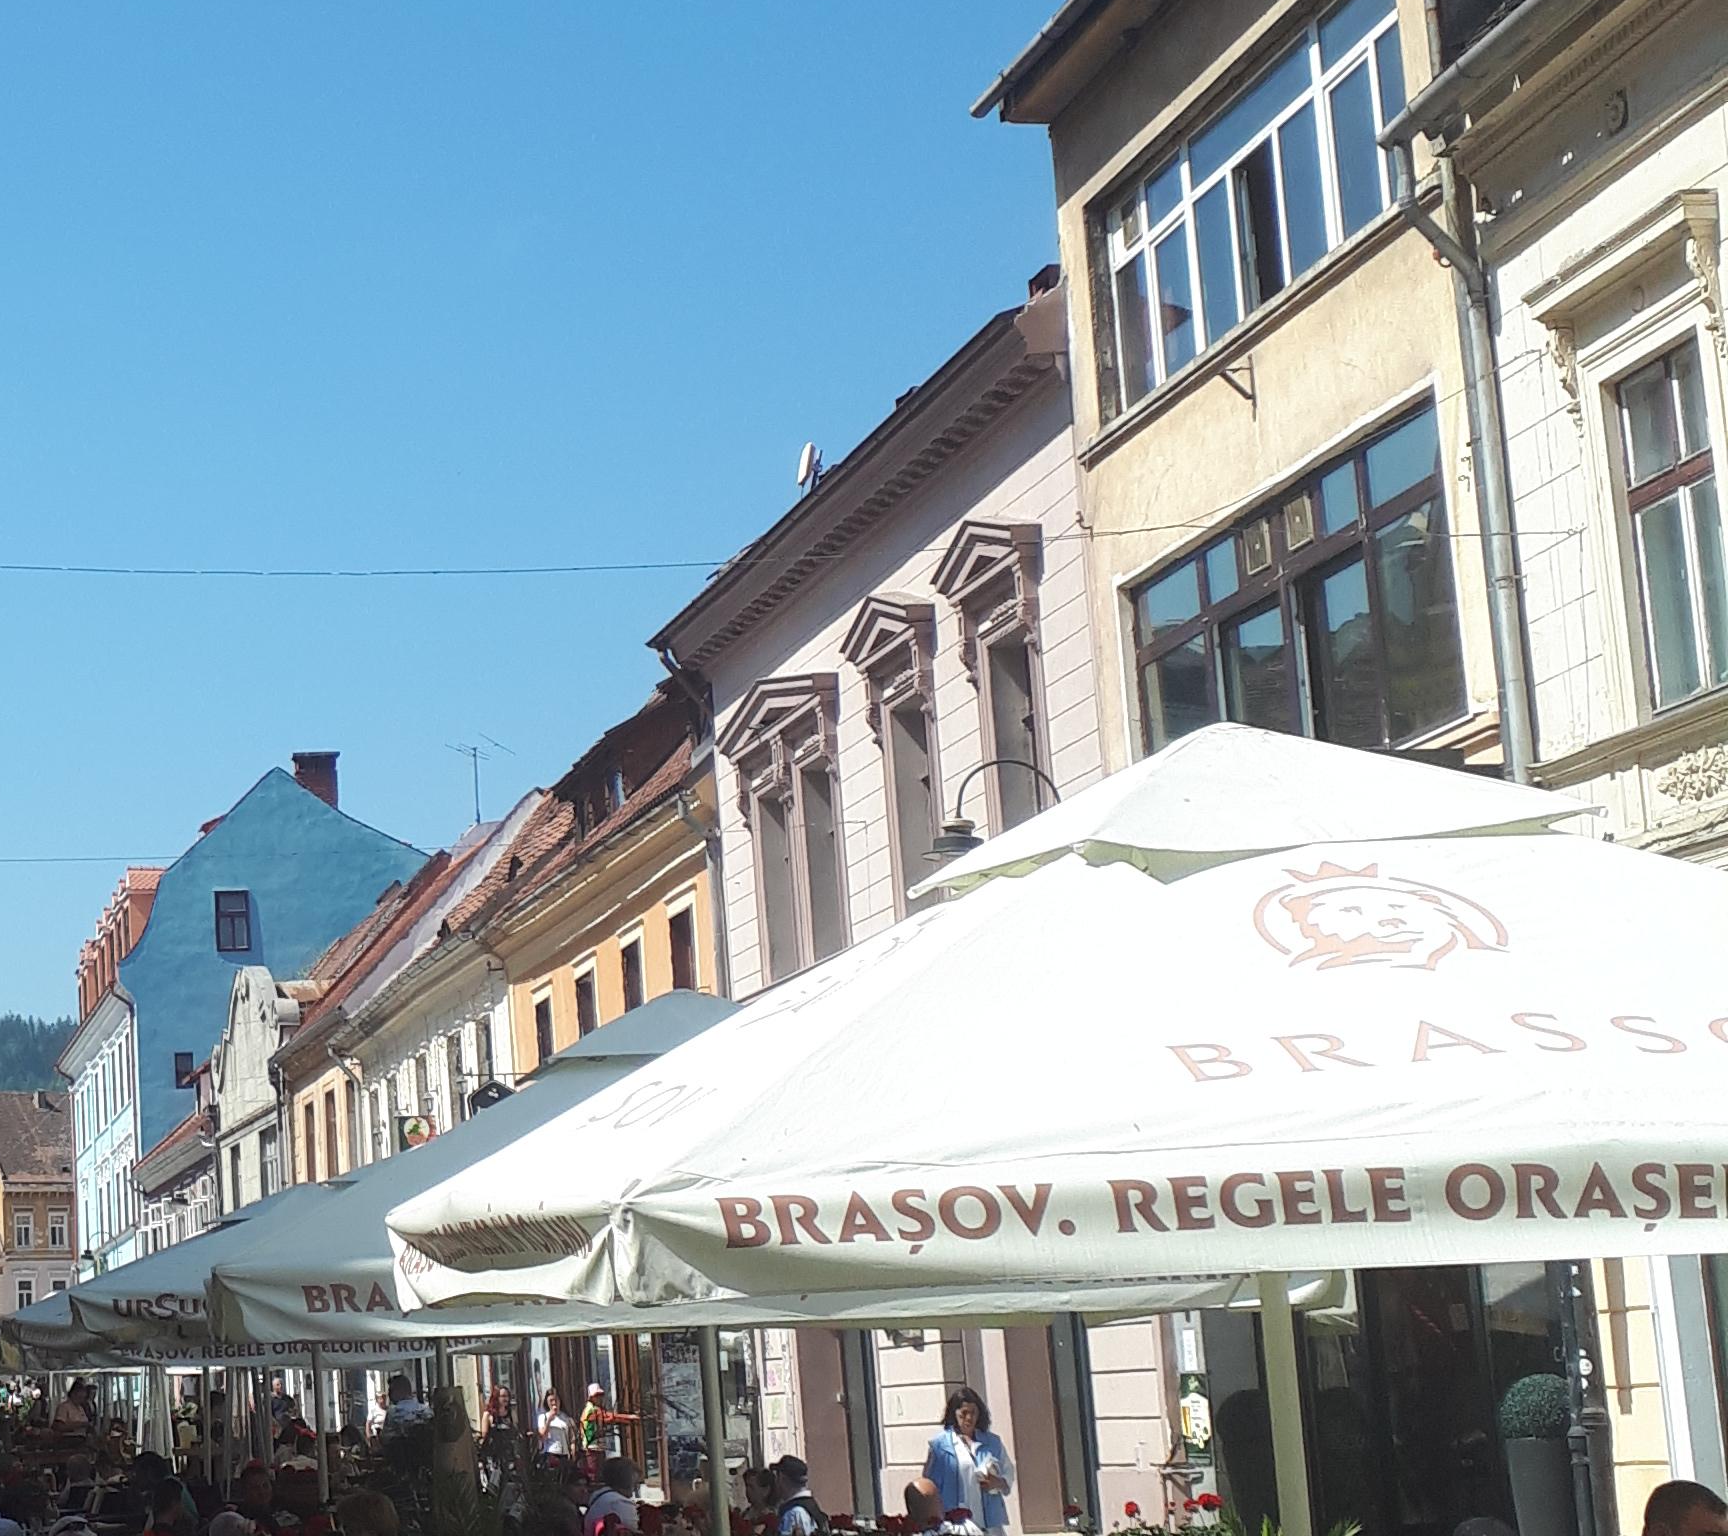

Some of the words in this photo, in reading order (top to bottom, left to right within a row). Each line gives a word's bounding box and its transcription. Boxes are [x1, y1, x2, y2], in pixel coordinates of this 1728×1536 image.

[1165, 1011, 1728, 1082] BRASS
[715, 1183, 1077, 1255] BRAȘOV.
[1106, 1167, 1412, 1234] REGELE
[112, 1293, 207, 1321] URSU
[302, 1282, 395, 1314] BRA
[202, 1342, 265, 1360] REGELE
[272, 1340, 367, 1355] ORAELOR
